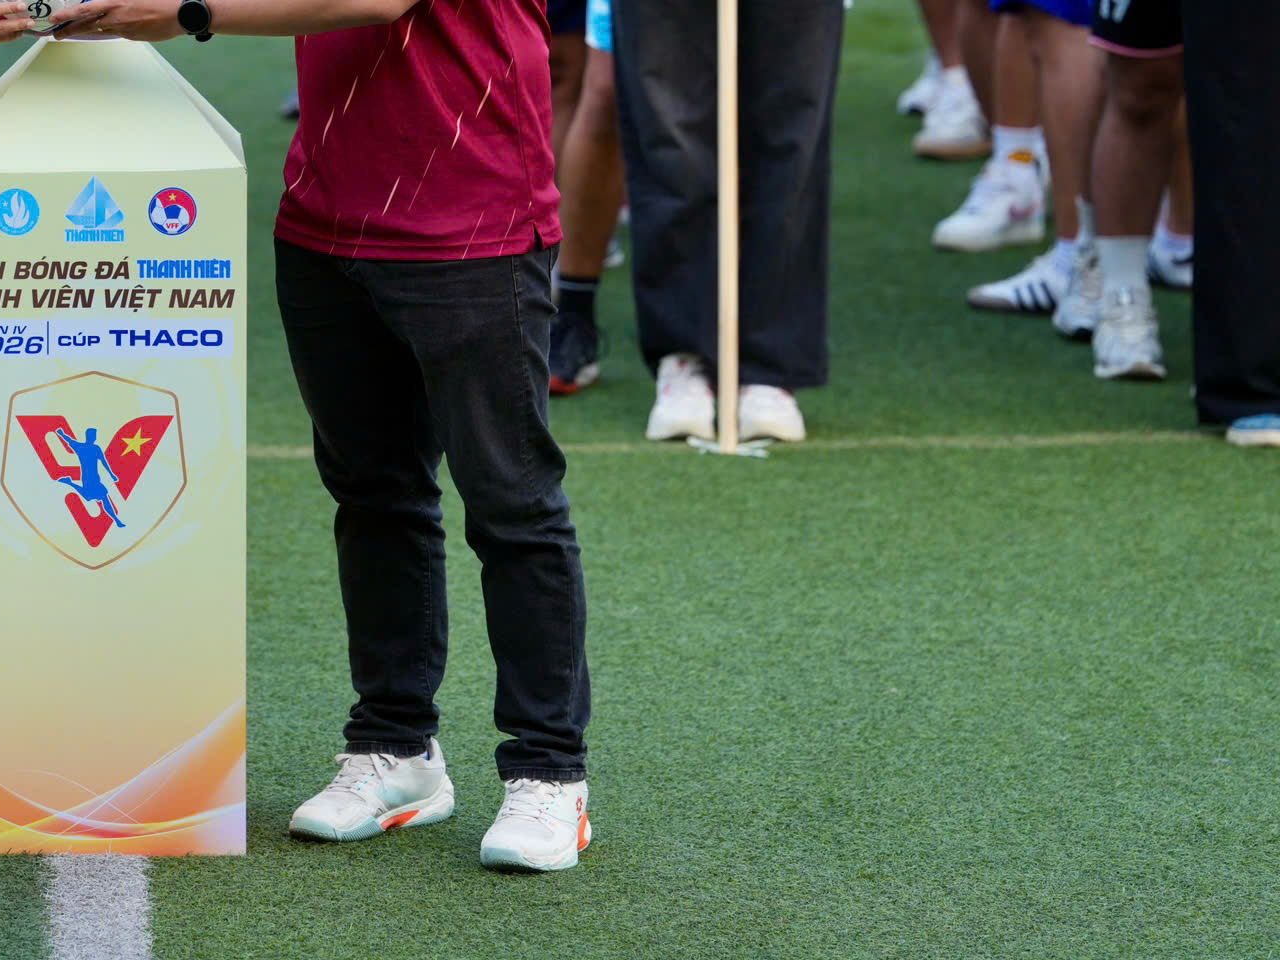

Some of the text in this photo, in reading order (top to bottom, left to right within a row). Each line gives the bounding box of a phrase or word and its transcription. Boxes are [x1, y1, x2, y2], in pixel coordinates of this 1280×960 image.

[166, 222, 180, 230] VFF
[14, 256, 88, 280] BÓNG
[94, 256, 131, 280] ĐÁ
[31, 284, 97, 309] VIÊN
[104, 284, 162, 313] VIỆT
[168, 289, 235, 309] NAM
[13, 325, 27, 335] IV
[57, 329, 223, 347] CÚP THACO
